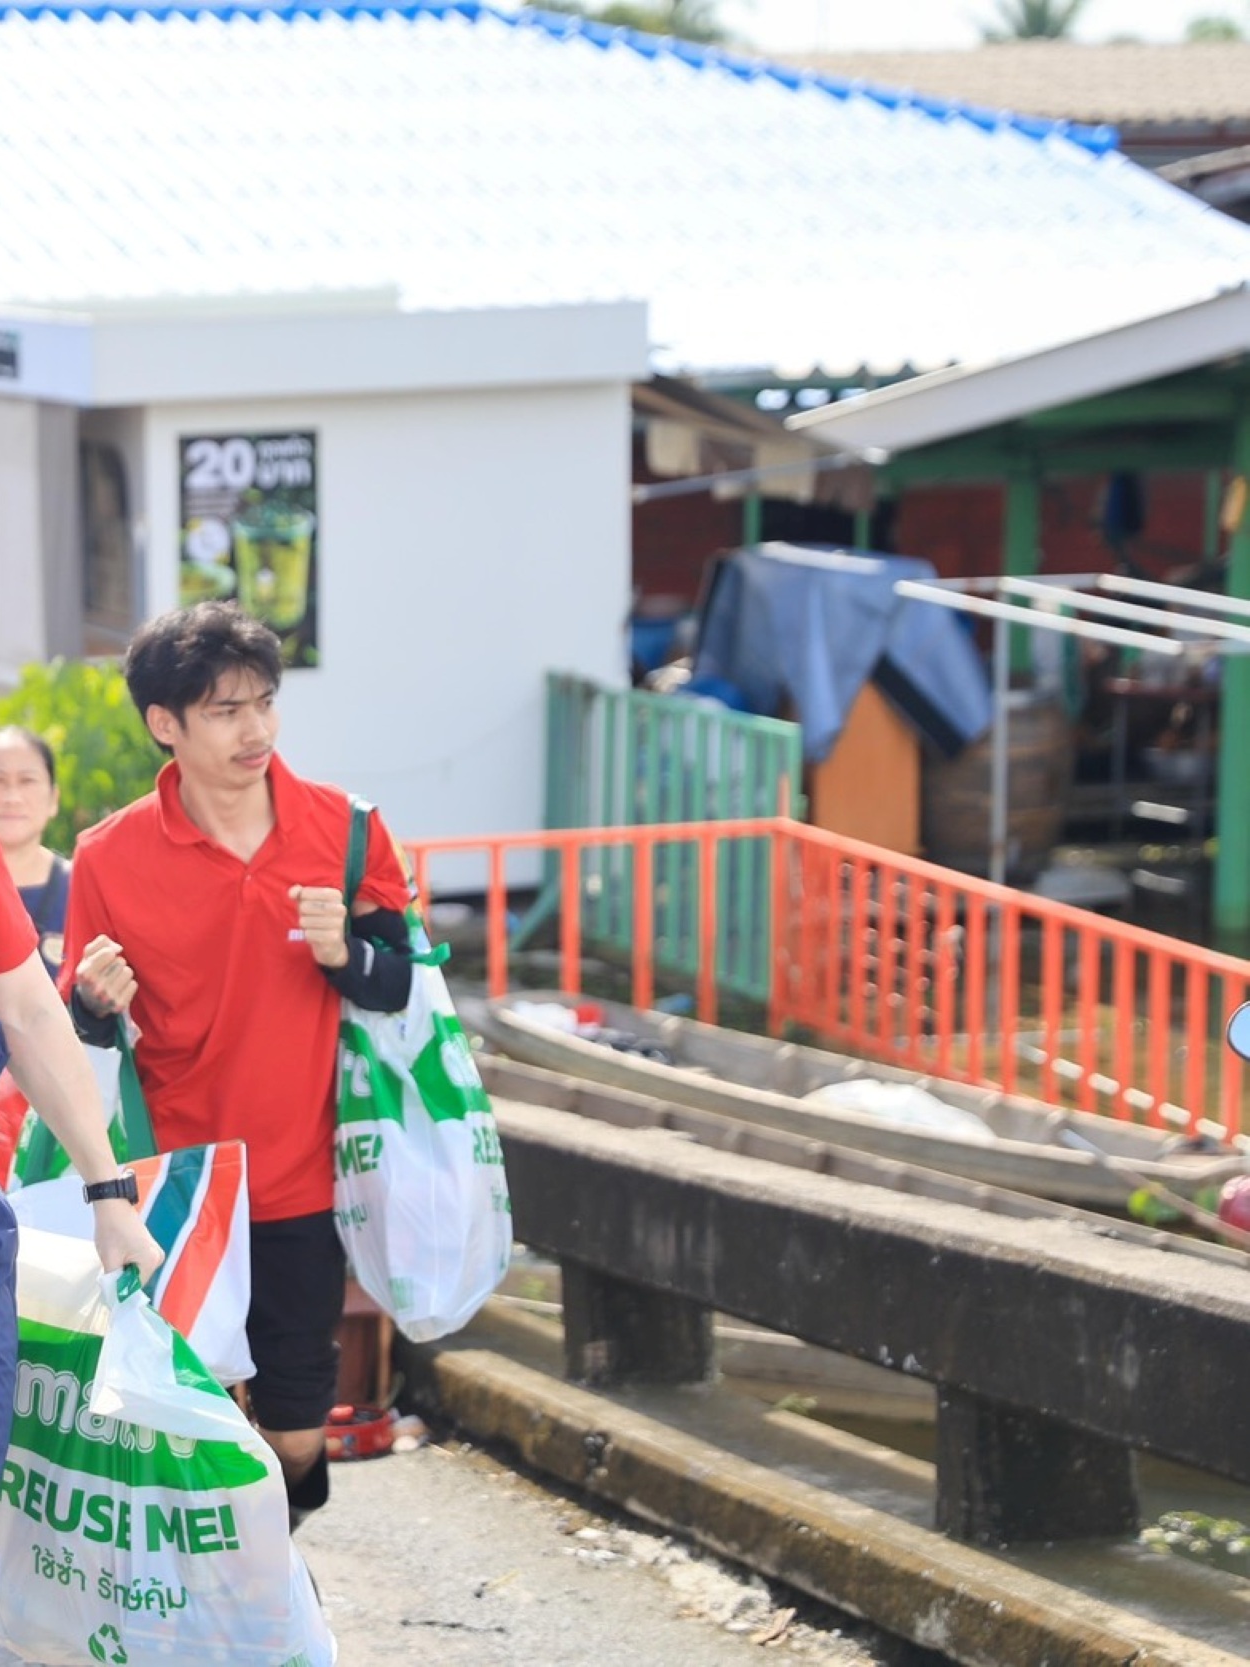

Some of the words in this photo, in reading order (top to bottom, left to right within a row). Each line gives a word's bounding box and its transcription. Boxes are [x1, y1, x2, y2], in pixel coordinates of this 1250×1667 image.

[184, 438, 254, 488] 20
[144, 1503, 241, 1555] ME!
[32, 1543, 87, 1592] ใช้ซ้ำ
[96, 1567, 188, 1619] รักษ์คุ้ม
